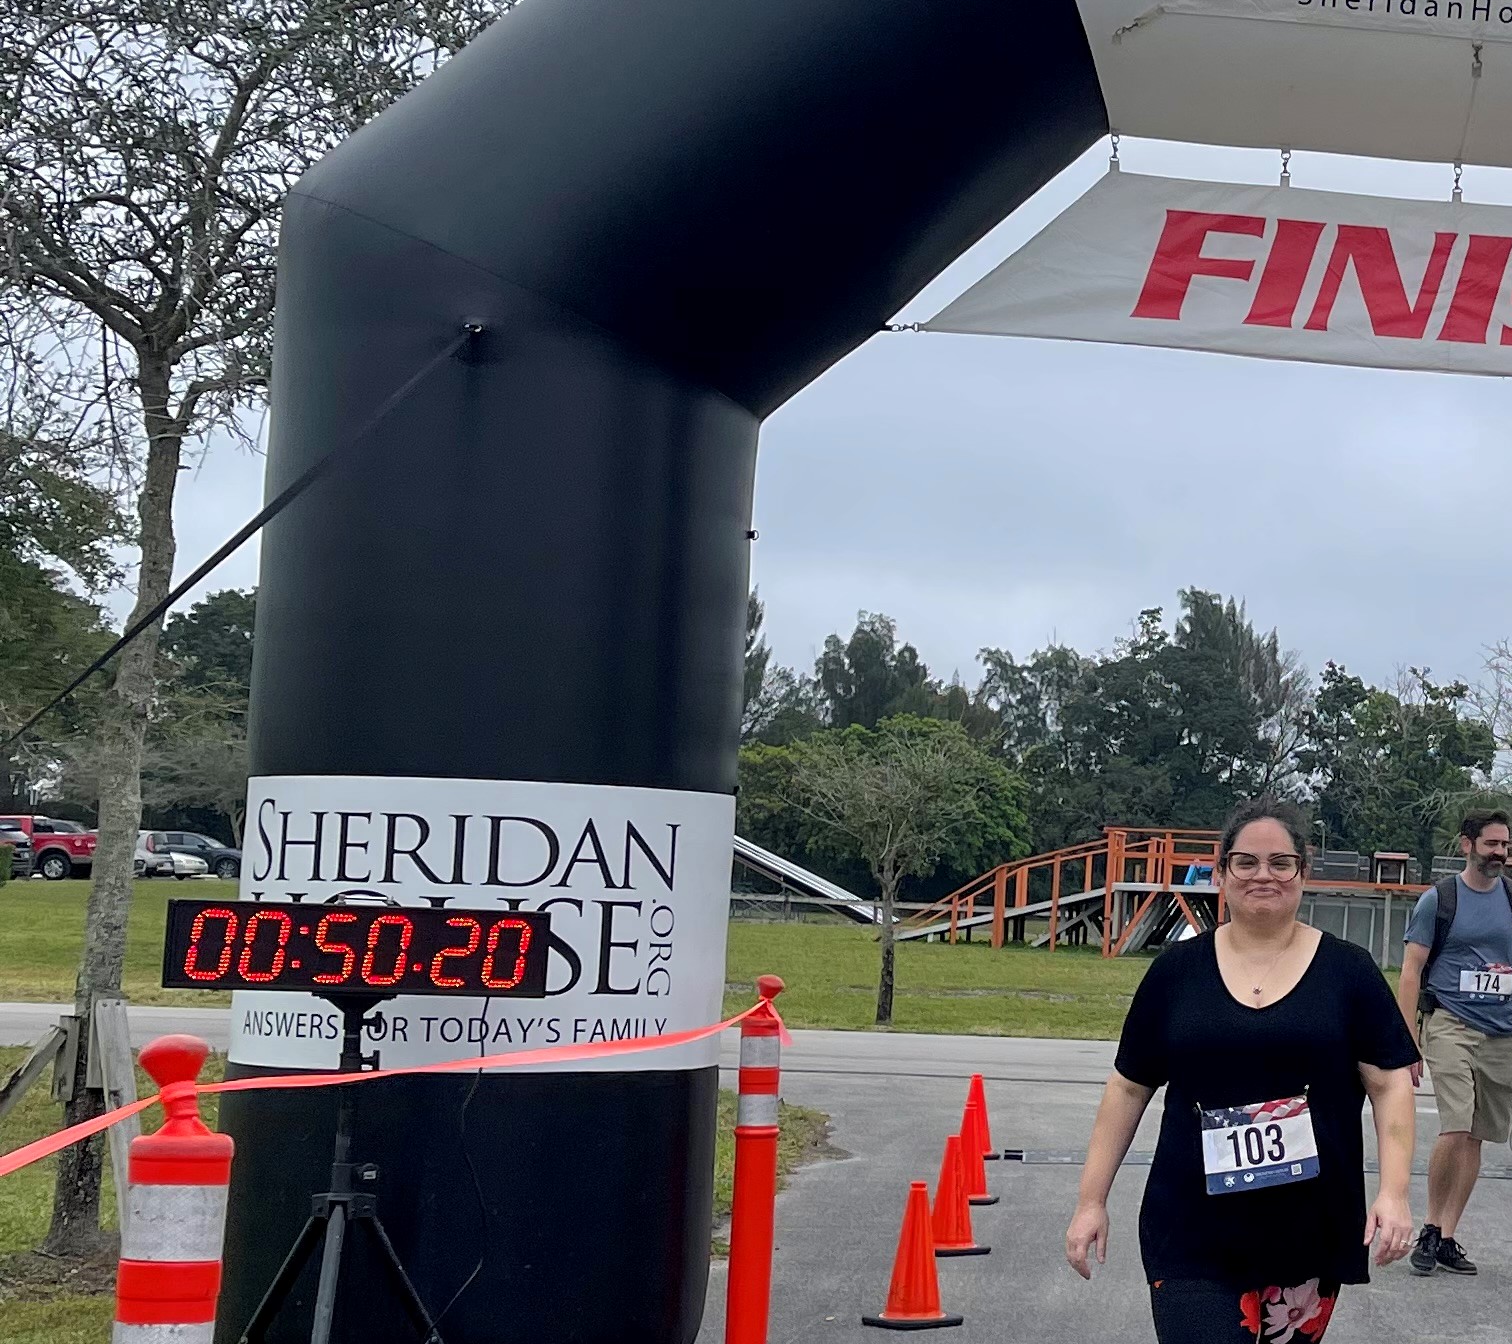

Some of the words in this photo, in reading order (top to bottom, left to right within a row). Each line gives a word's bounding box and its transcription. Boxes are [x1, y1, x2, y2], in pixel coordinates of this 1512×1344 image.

[252, 798, 681, 893] SHERIDAN
[1475, 973, 1500, 992] 174
[243, 1010, 339, 1040] ANSWERS
[366, 1016, 409, 1042] OR
[420, 1017, 561, 1044] TODAY'S
[1226, 1123, 1285, 1168] 103
